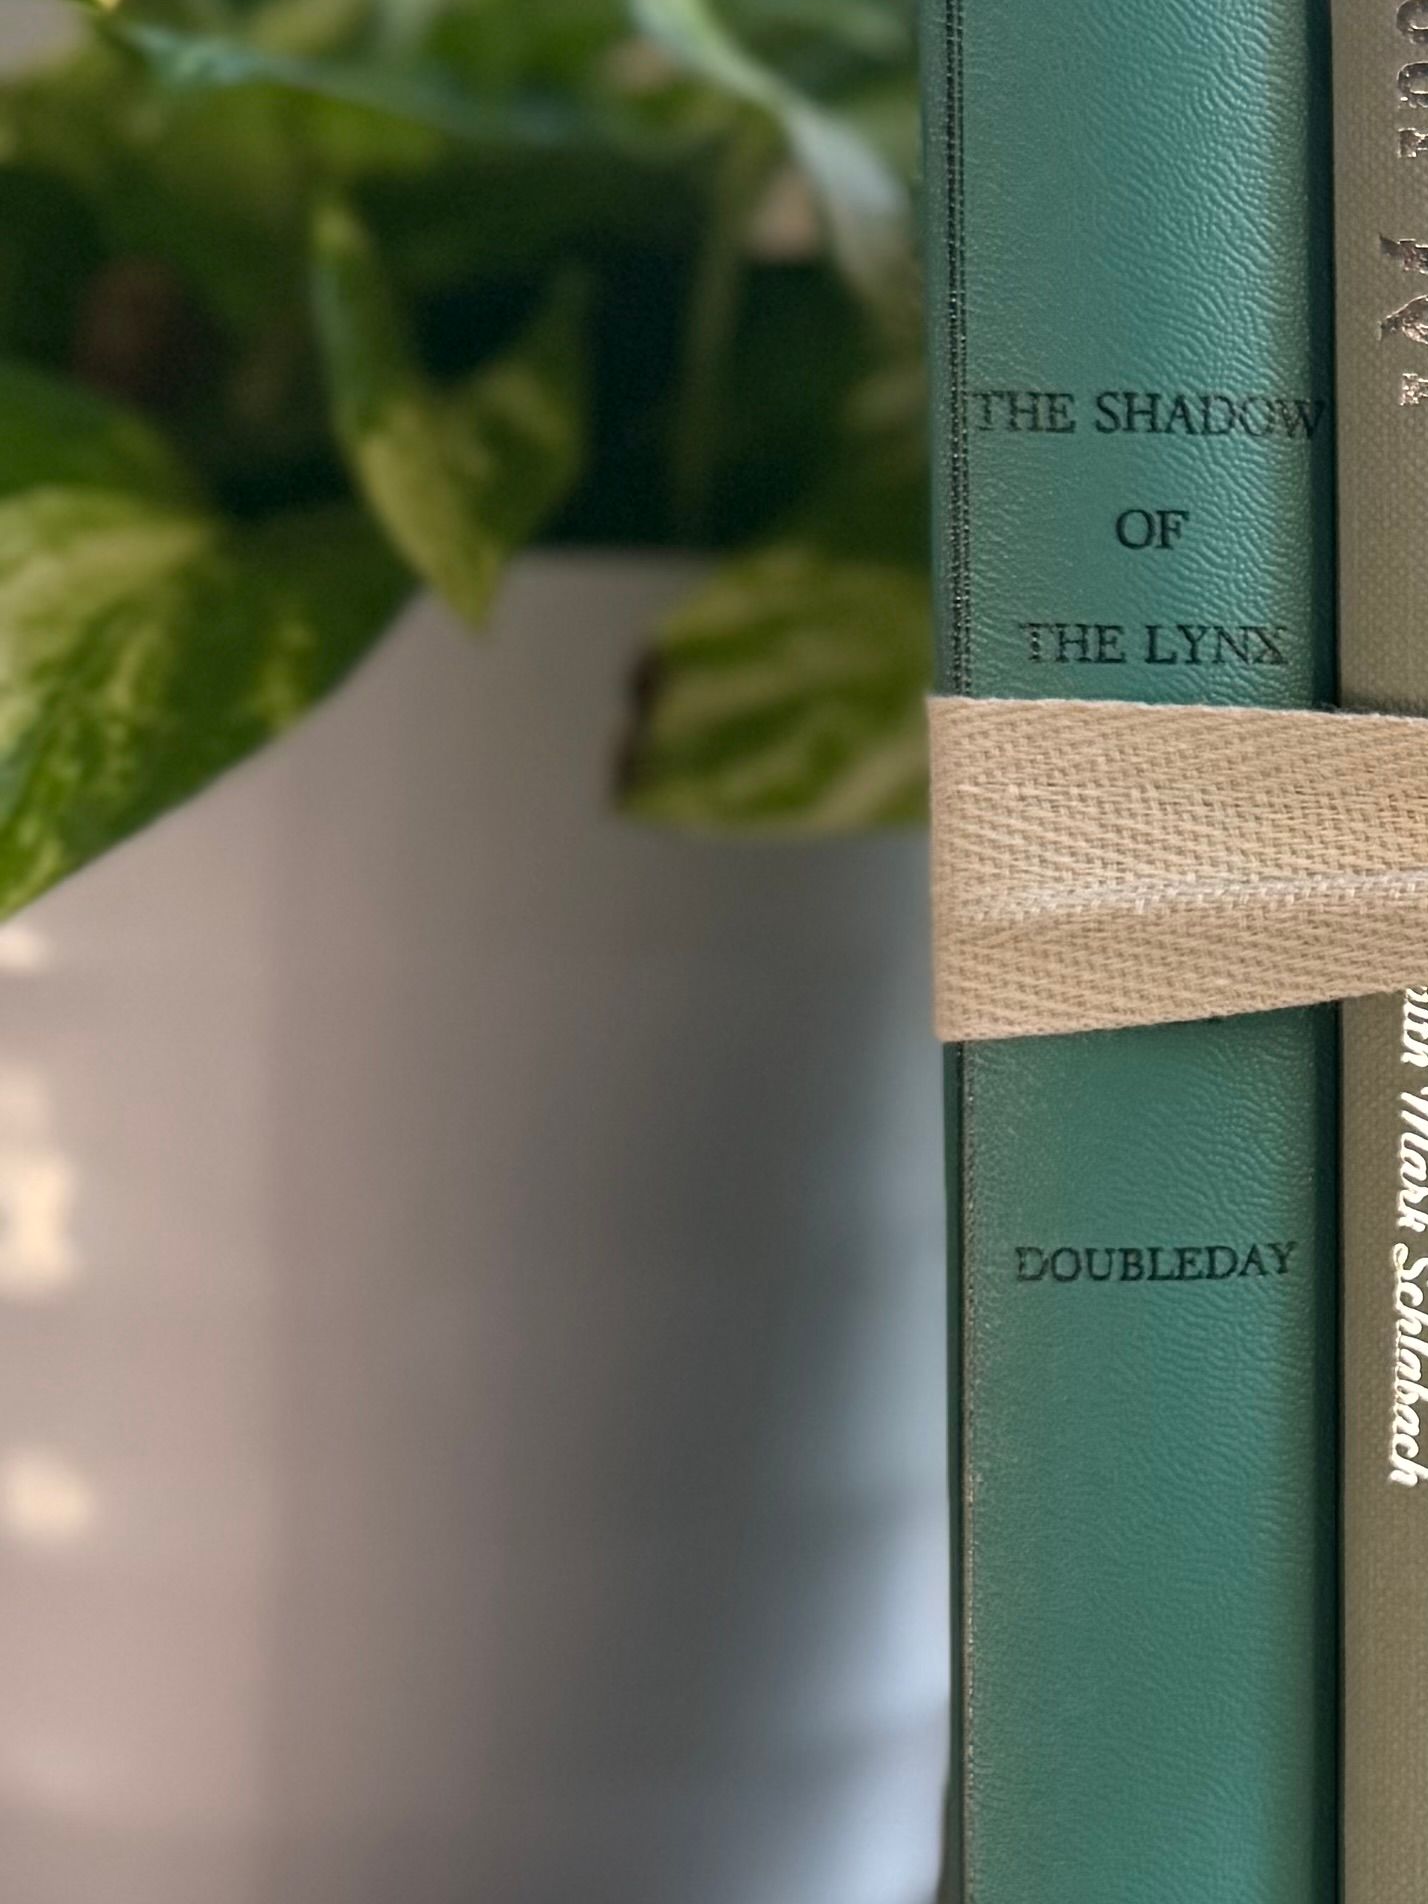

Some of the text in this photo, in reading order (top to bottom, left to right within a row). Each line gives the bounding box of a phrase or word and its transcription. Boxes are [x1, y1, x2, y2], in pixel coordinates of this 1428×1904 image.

[972, 389, 1328, 440] THE SHADOW
[1115, 508, 1190, 550] OF
[1019, 622, 1289, 667] THE LYNX
[1014, 1241, 1299, 1283] DOUBLEDAY
